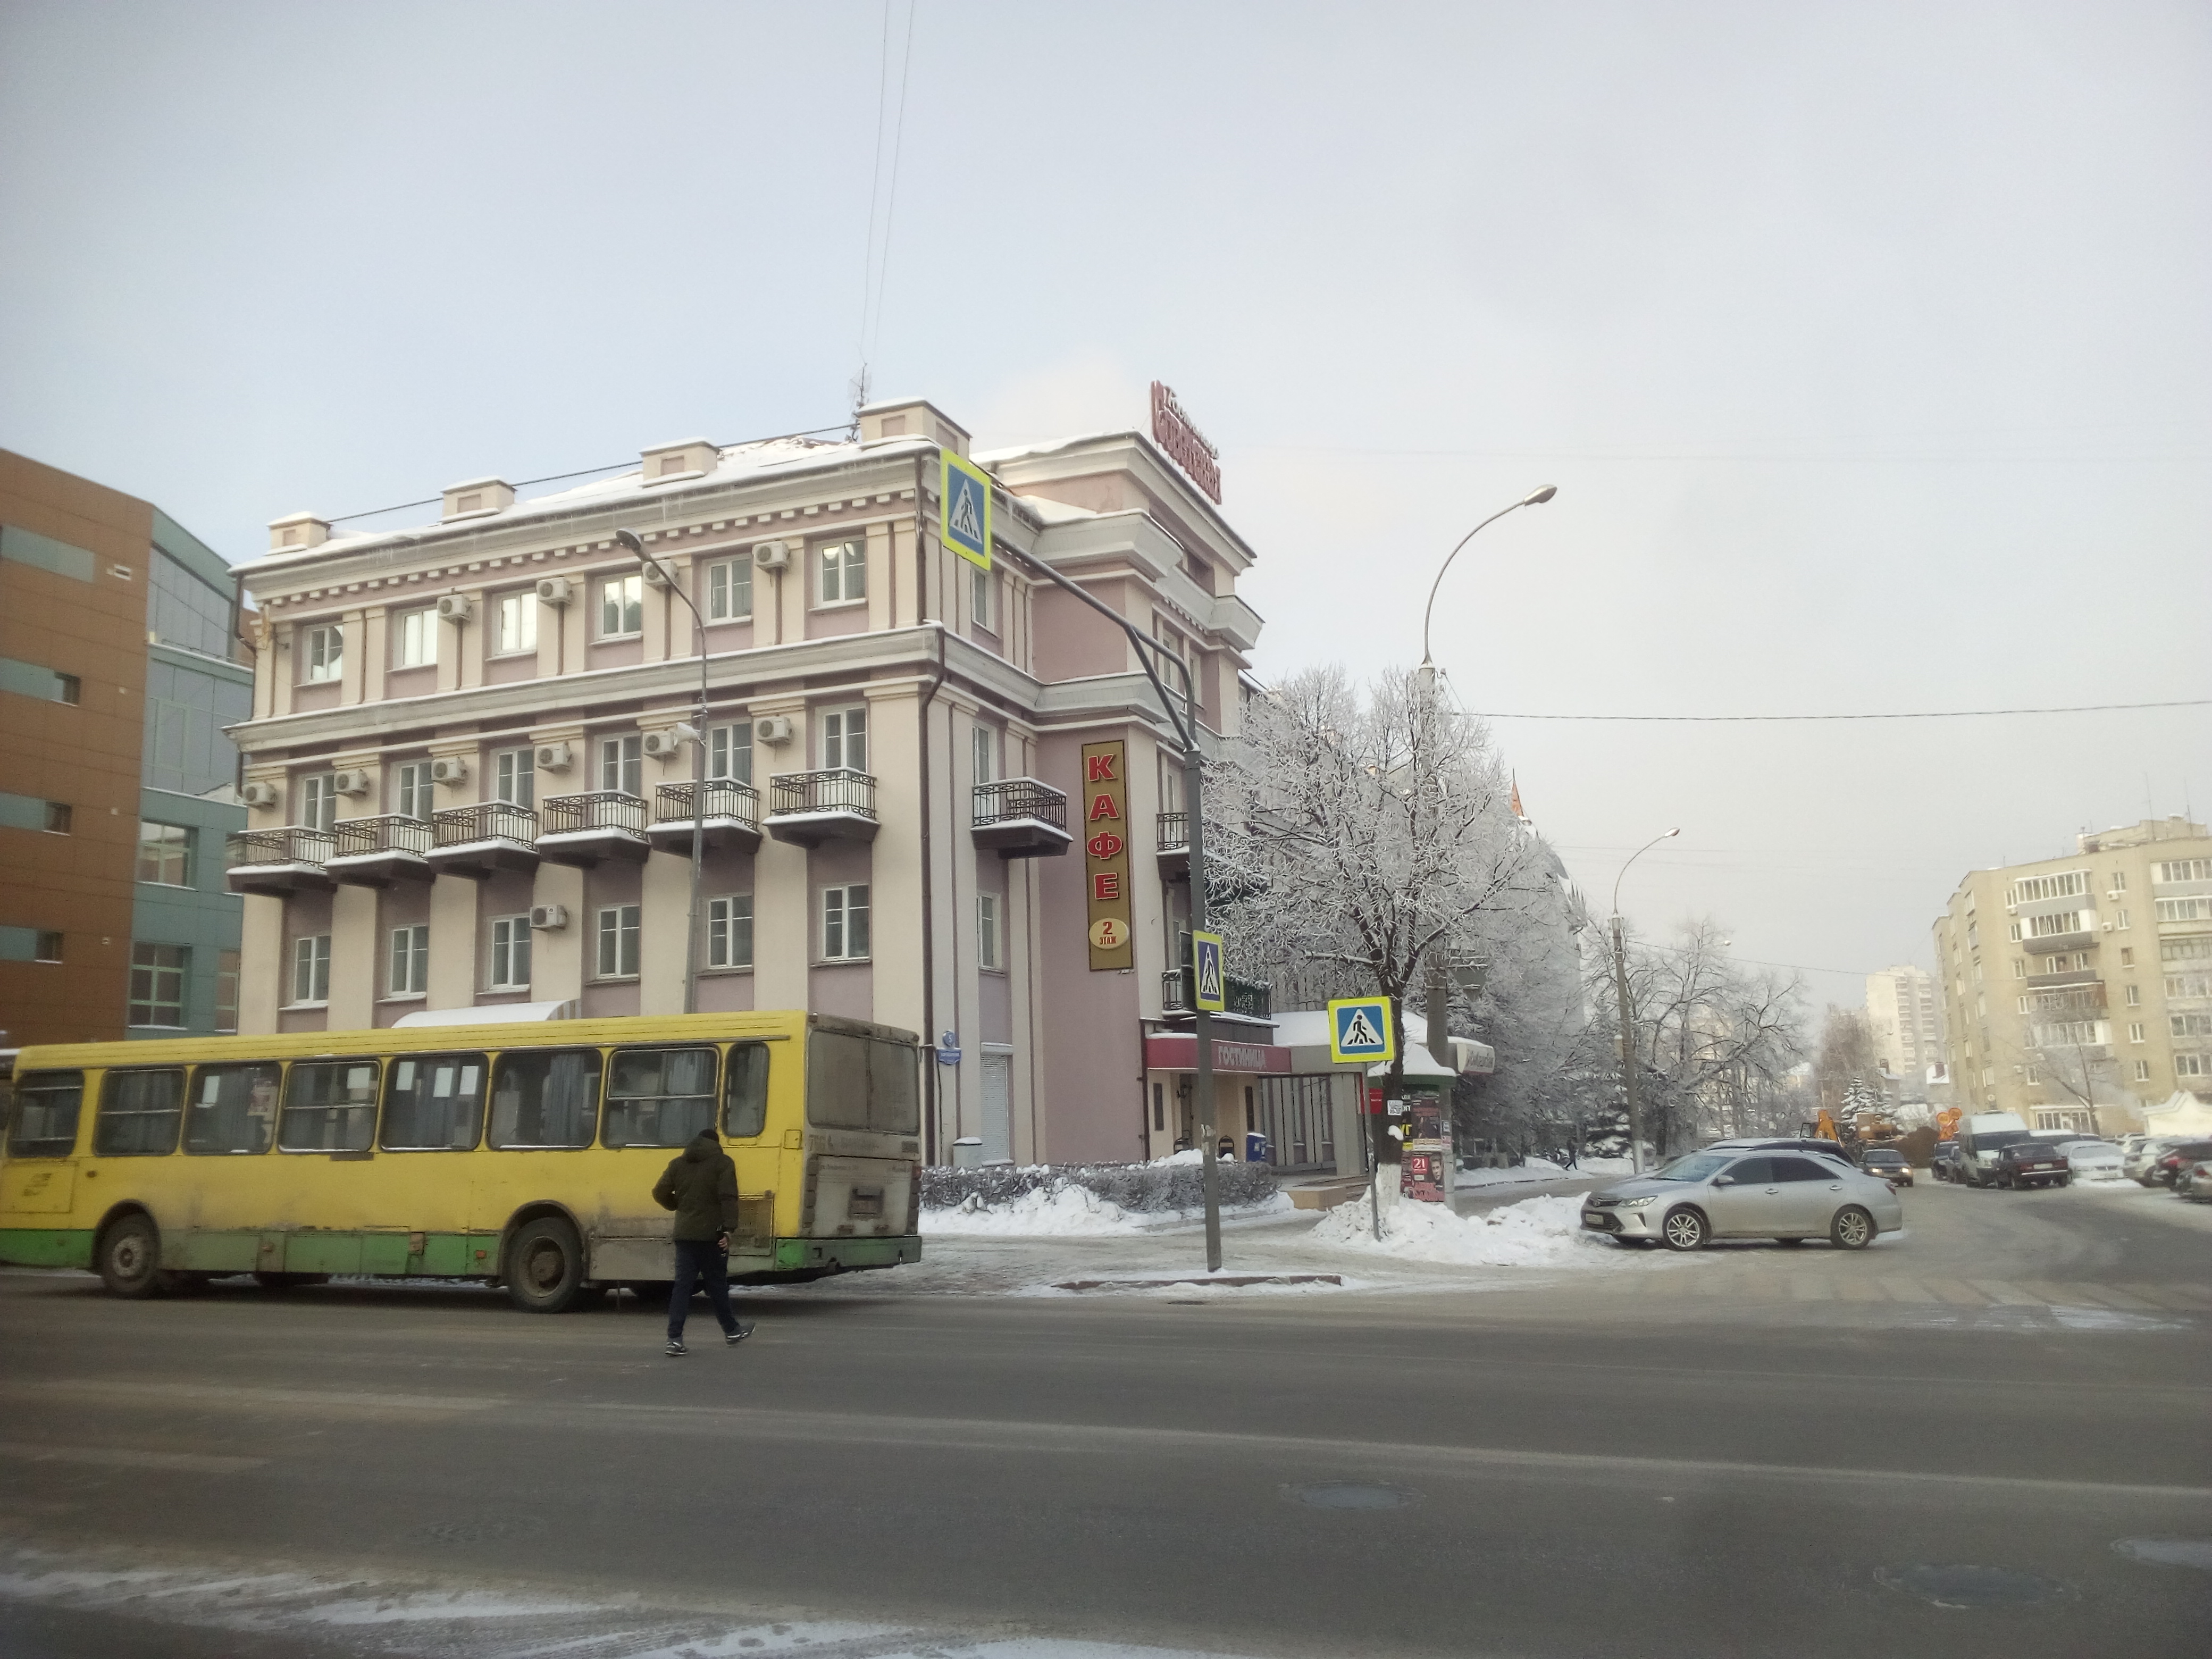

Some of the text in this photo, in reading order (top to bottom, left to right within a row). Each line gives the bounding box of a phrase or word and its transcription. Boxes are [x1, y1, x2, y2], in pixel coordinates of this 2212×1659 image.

[1087, 753, 1122, 900] КАФЕ
[1102, 921, 1113, 935] 2
[1099, 936, 1117, 945] ЭТАЖ
[1218, 1045, 1267, 1070] ГОСТИНИЦА
[1413, 1158, 1426, 1168] 21
